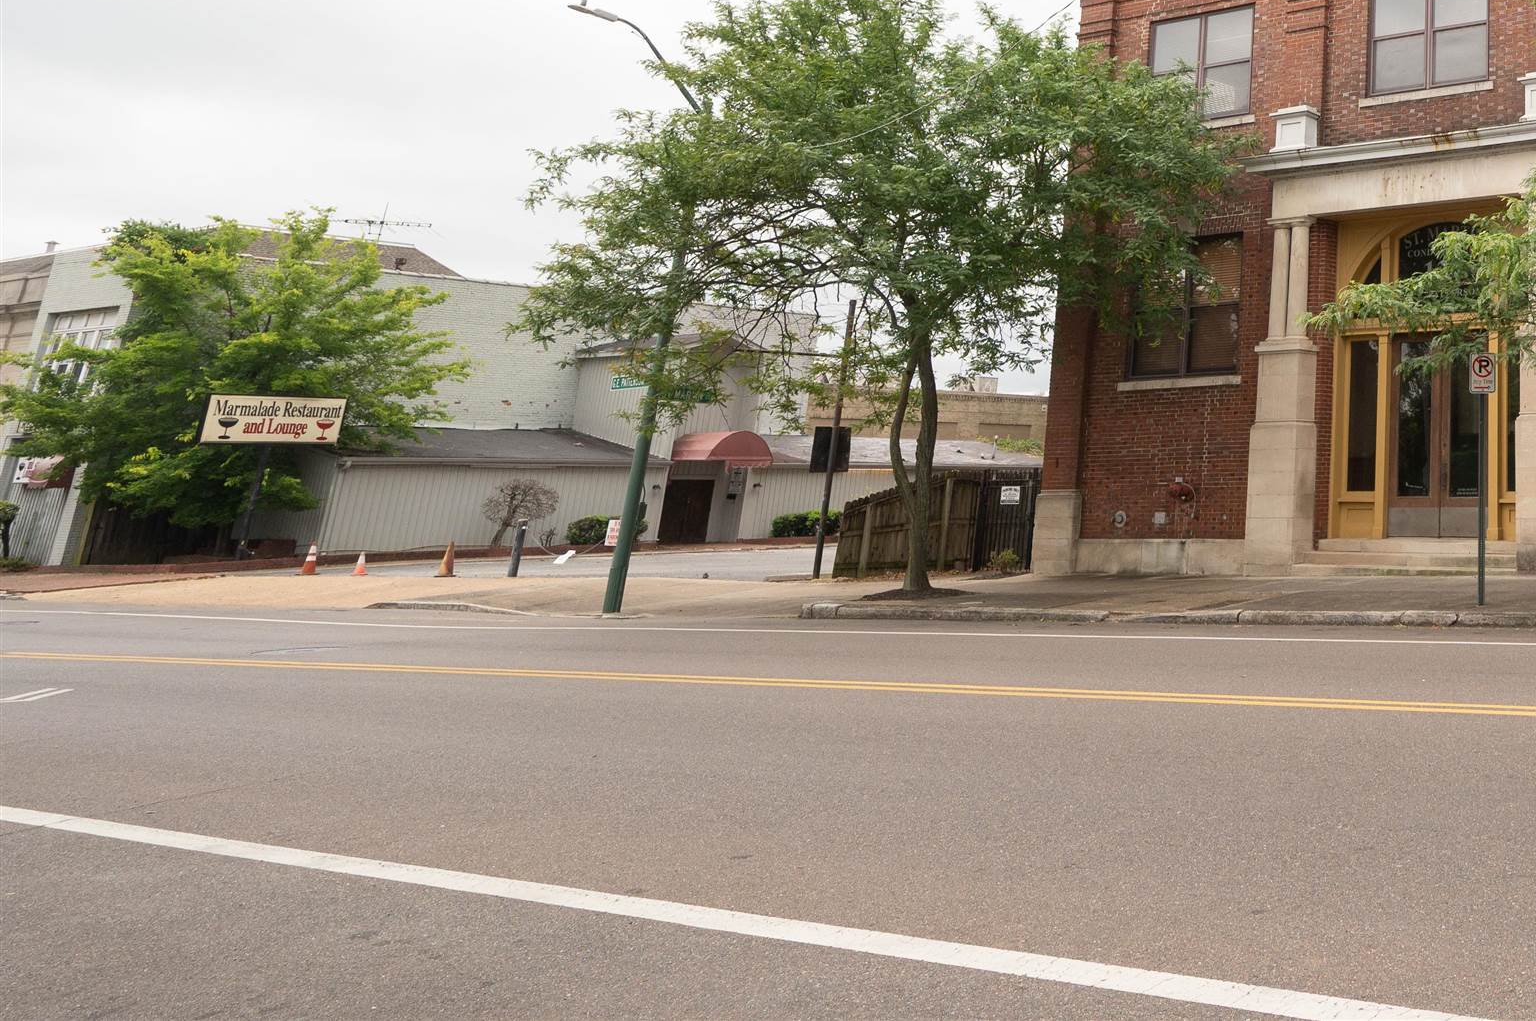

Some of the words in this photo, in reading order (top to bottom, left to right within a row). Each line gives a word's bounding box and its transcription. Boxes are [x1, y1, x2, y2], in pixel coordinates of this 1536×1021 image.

[213, 399, 281, 417] Marmalade
[283, 401, 342, 419] Restaurant
[242, 418, 266, 434] and
[266, 418, 308, 439] Lounge
